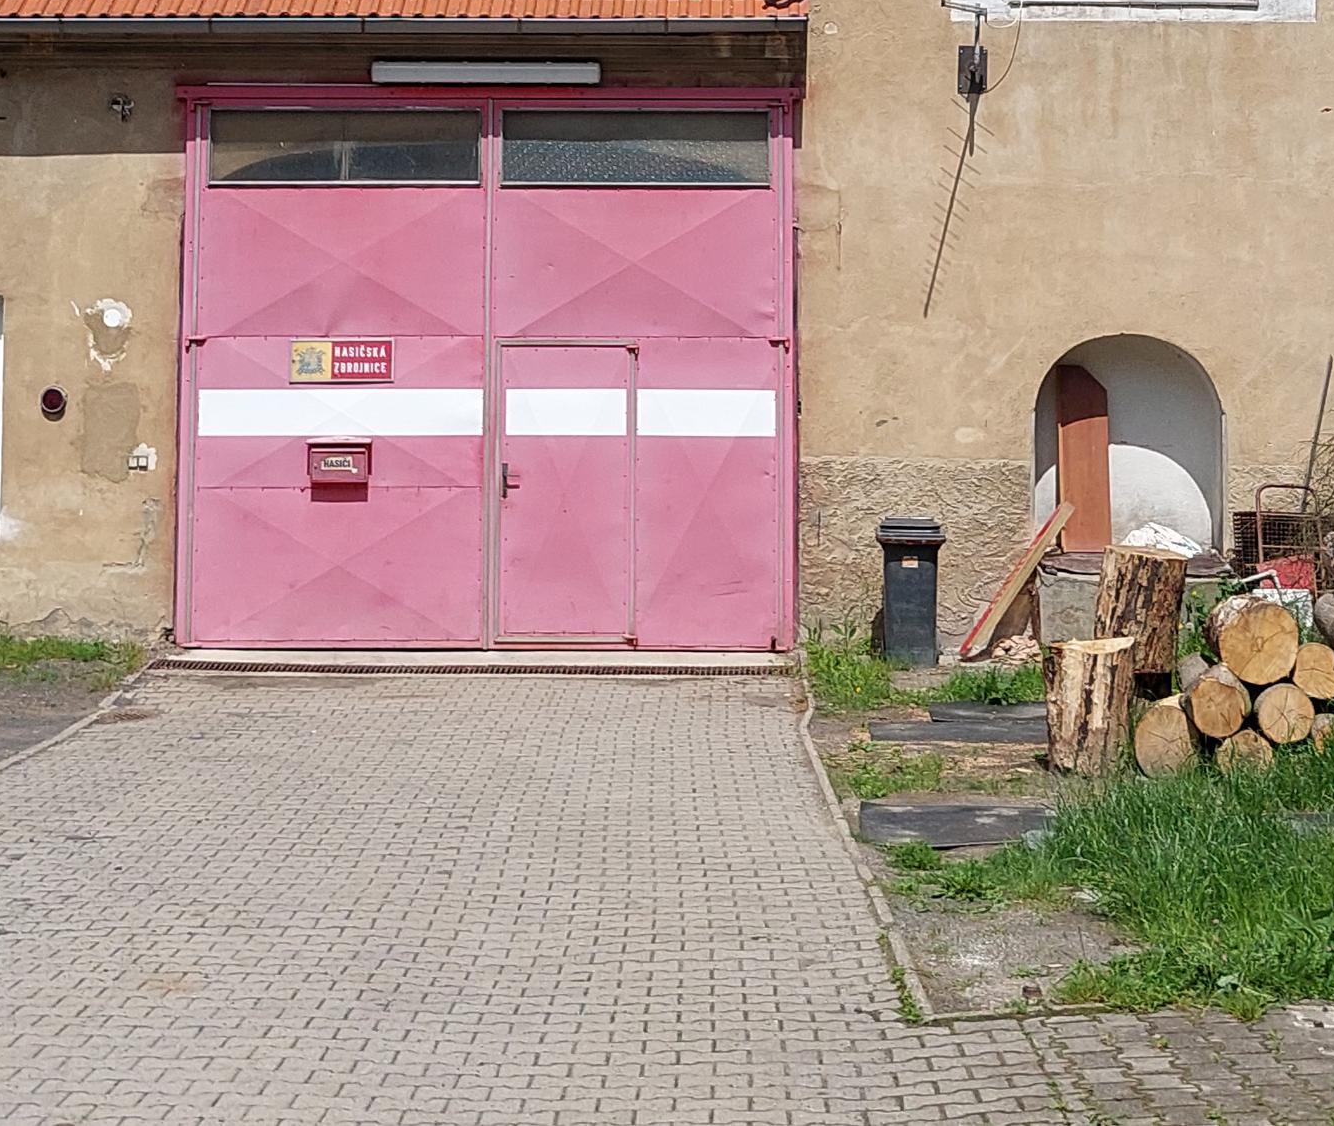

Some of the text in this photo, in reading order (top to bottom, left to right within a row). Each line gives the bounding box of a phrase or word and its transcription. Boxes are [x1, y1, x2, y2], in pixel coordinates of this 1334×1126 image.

[334, 345, 386, 358] HASIČSKÁ
[334, 362, 387, 374] ZBROJNICE
[323, 458, 351, 468] HASIČI
